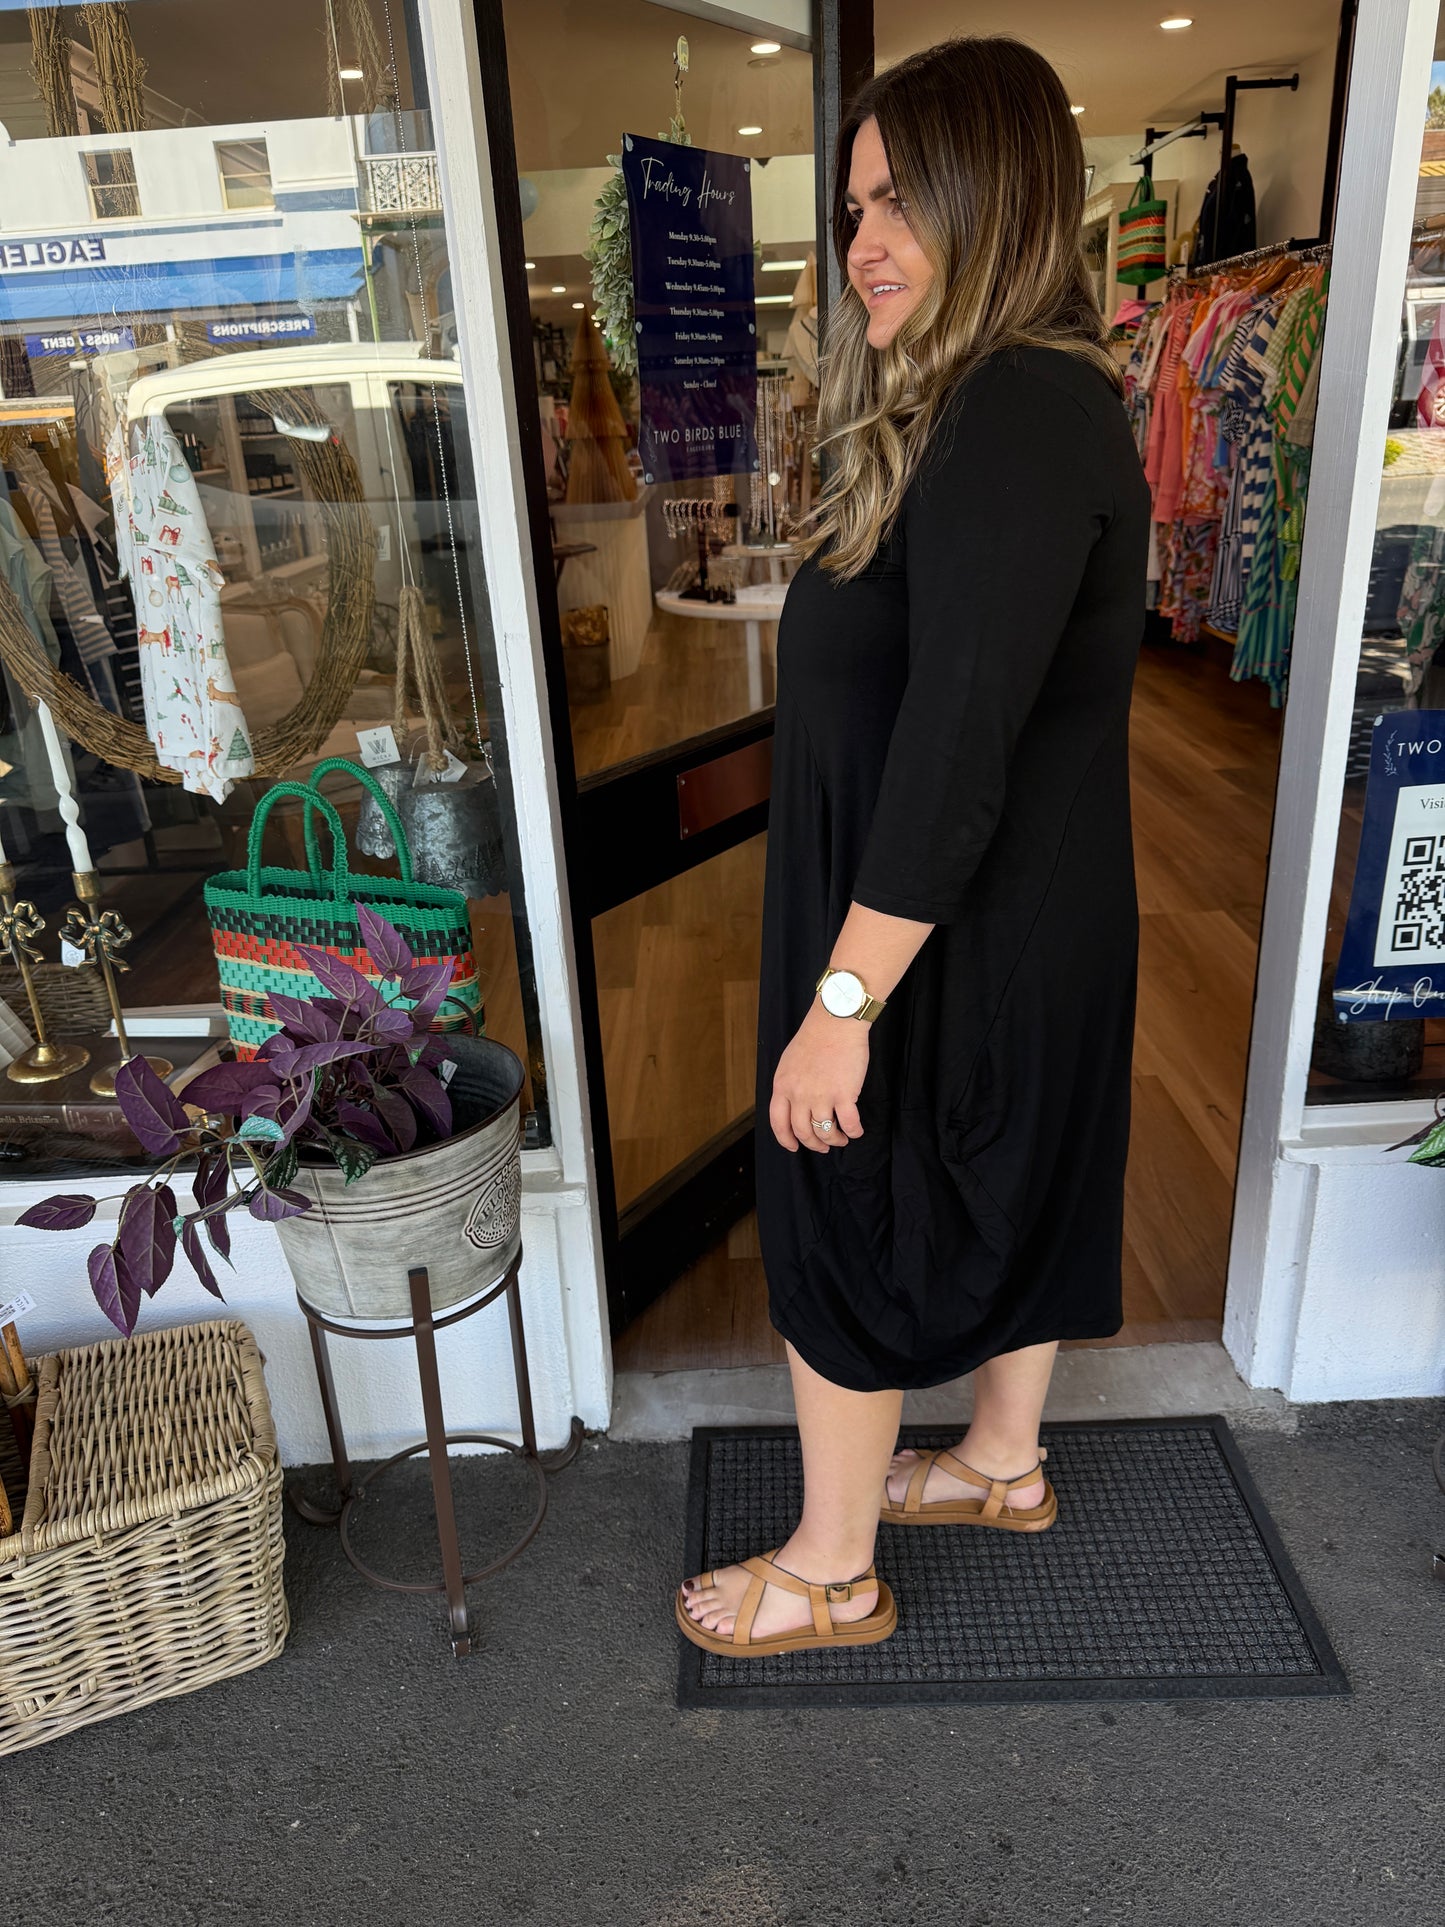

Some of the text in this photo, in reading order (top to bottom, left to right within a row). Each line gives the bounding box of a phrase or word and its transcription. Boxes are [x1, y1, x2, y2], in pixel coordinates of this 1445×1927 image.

[641, 156, 735, 208] Trading Hours
[669, 231, 688, 243] Monday
[667, 256, 687, 269] Tuesday
[665, 281, 692, 294] Wednesday
[670, 306, 691, 318] Thursday
[675, 331, 689, 342] Friday
[674, 356, 693, 367] Saturday
[683, 380, 700, 391] Sunday
[654, 424, 741, 445] TWO BIRDS BLUE
[1397, 739, 1442, 757] TWO
[1420, 797, 1445, 809] Visi
[1349, 975, 1407, 1021] Shop
